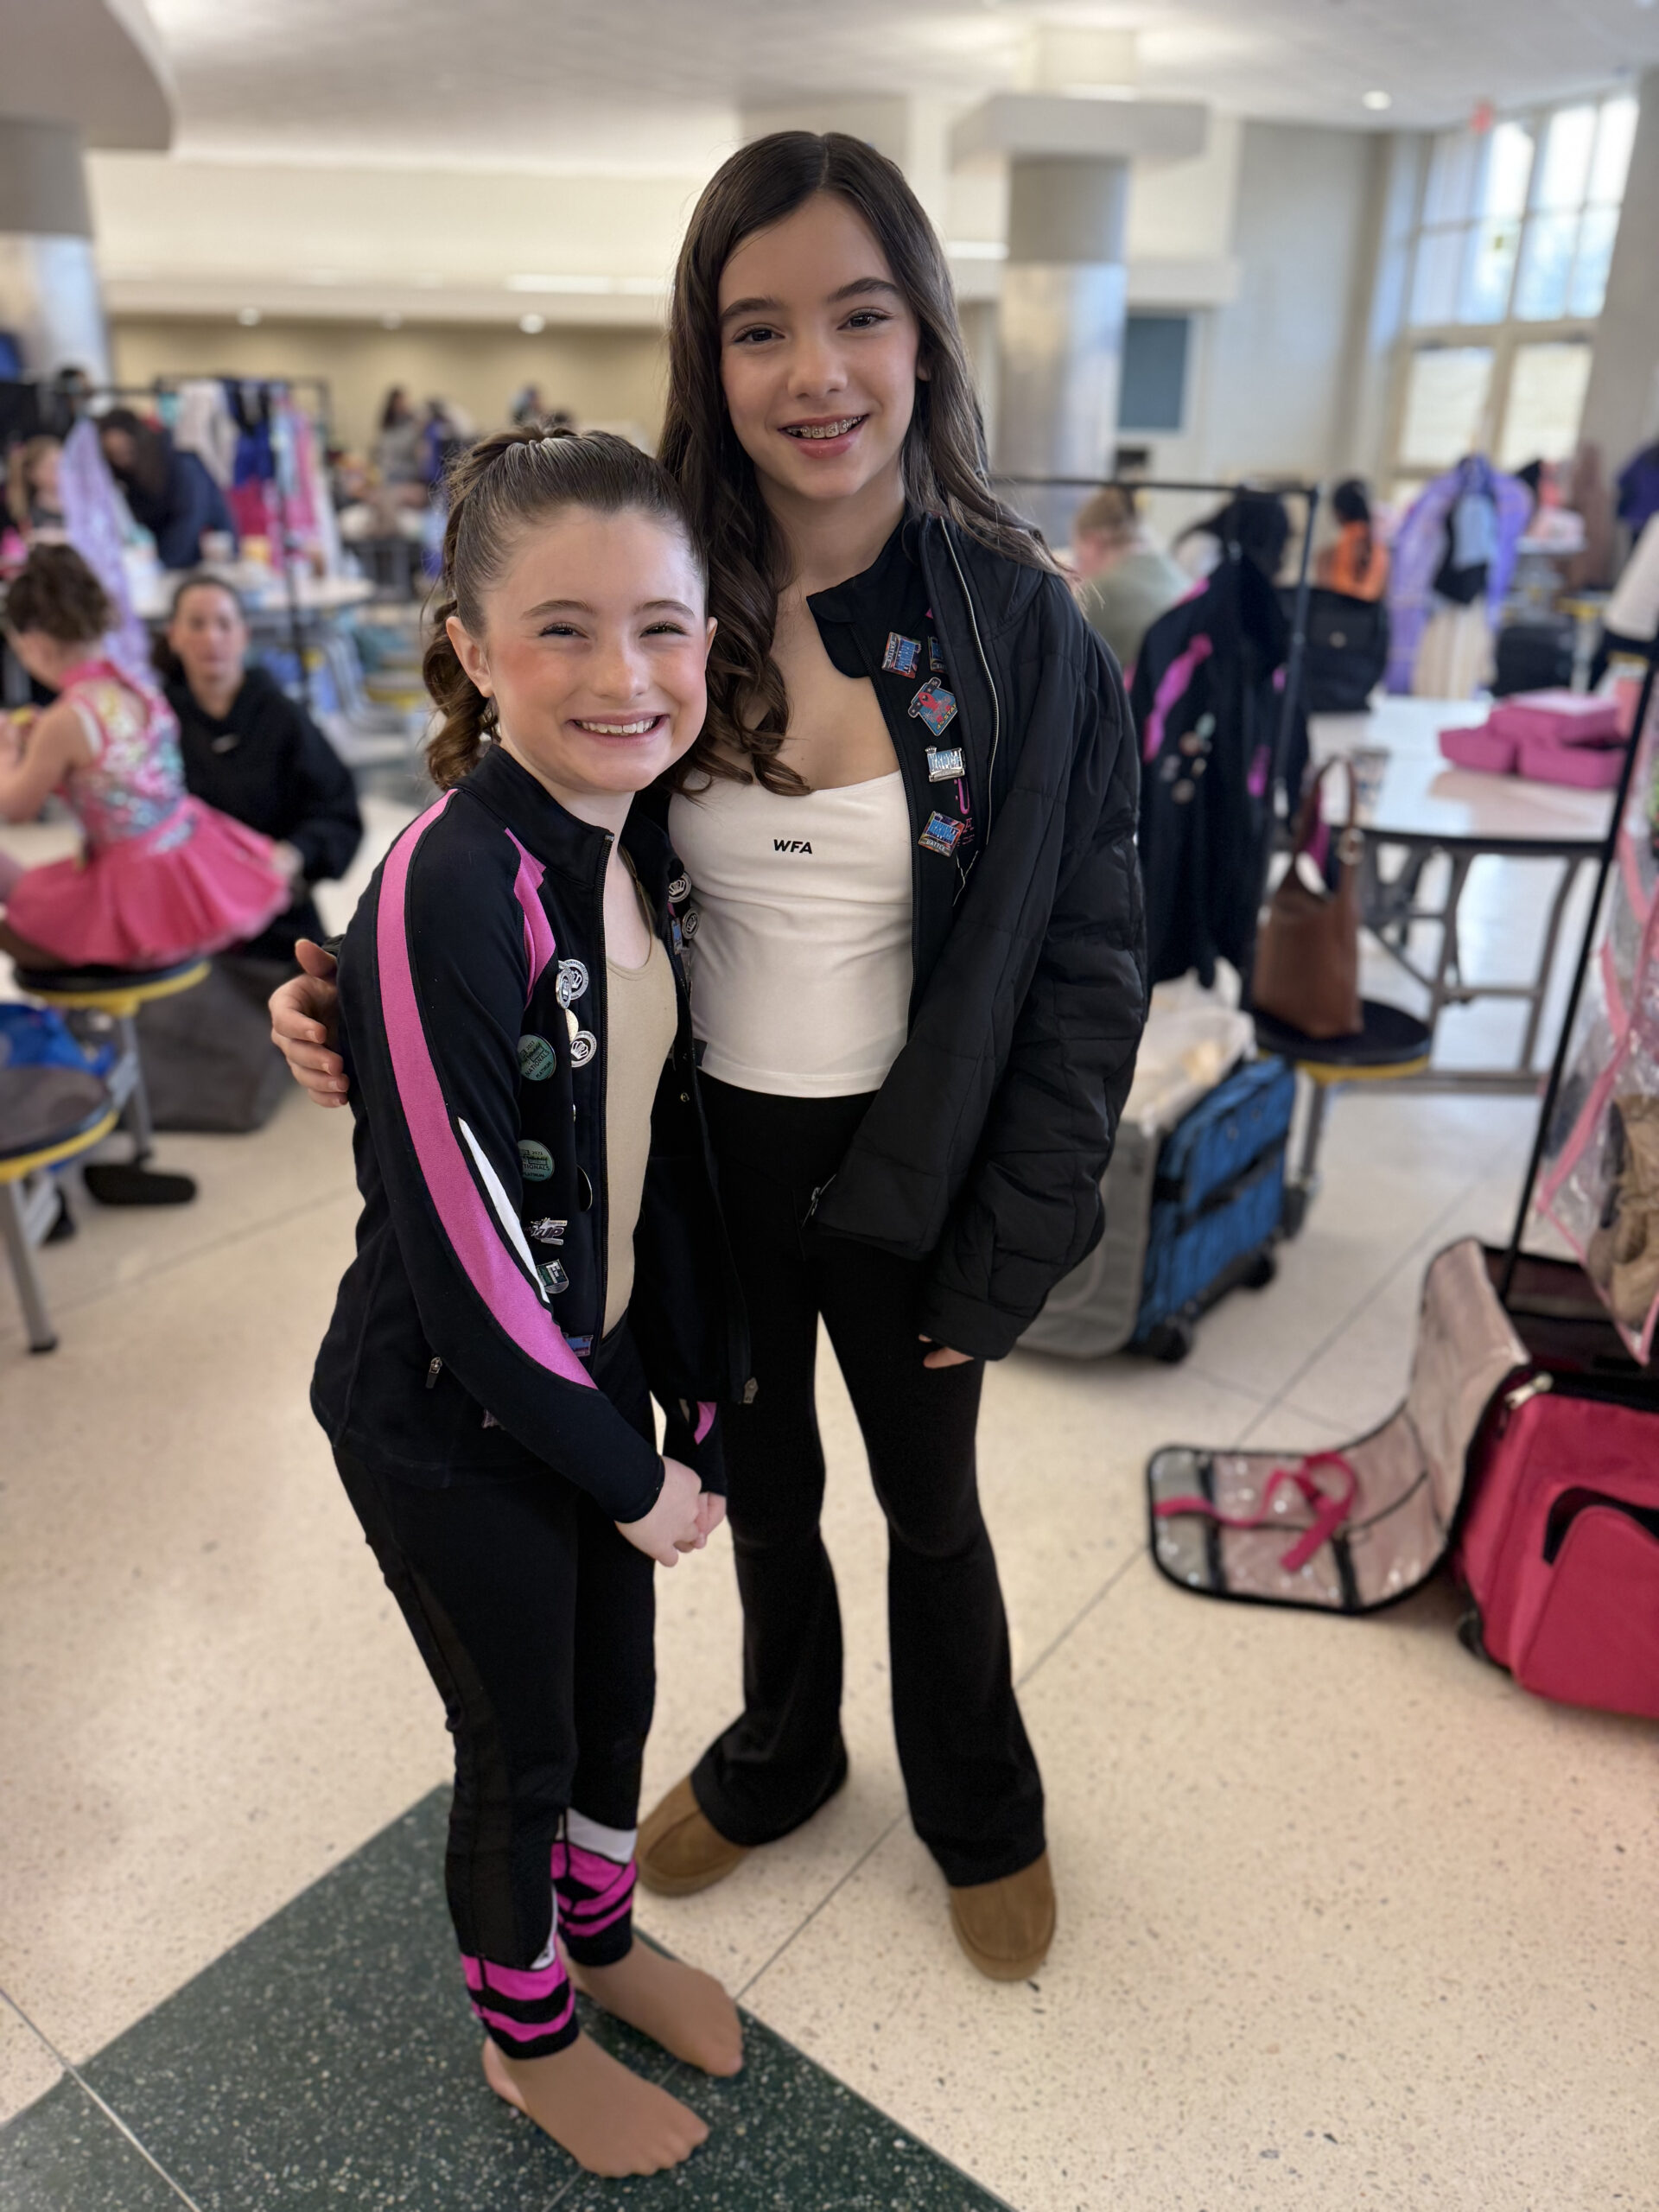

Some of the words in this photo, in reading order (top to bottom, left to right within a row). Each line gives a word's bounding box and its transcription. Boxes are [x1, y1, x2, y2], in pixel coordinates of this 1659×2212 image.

[773, 839, 813, 855] WFA
[925, 838, 946, 852] BATTLE
[524, 1049, 550, 1077] NATIONALS
